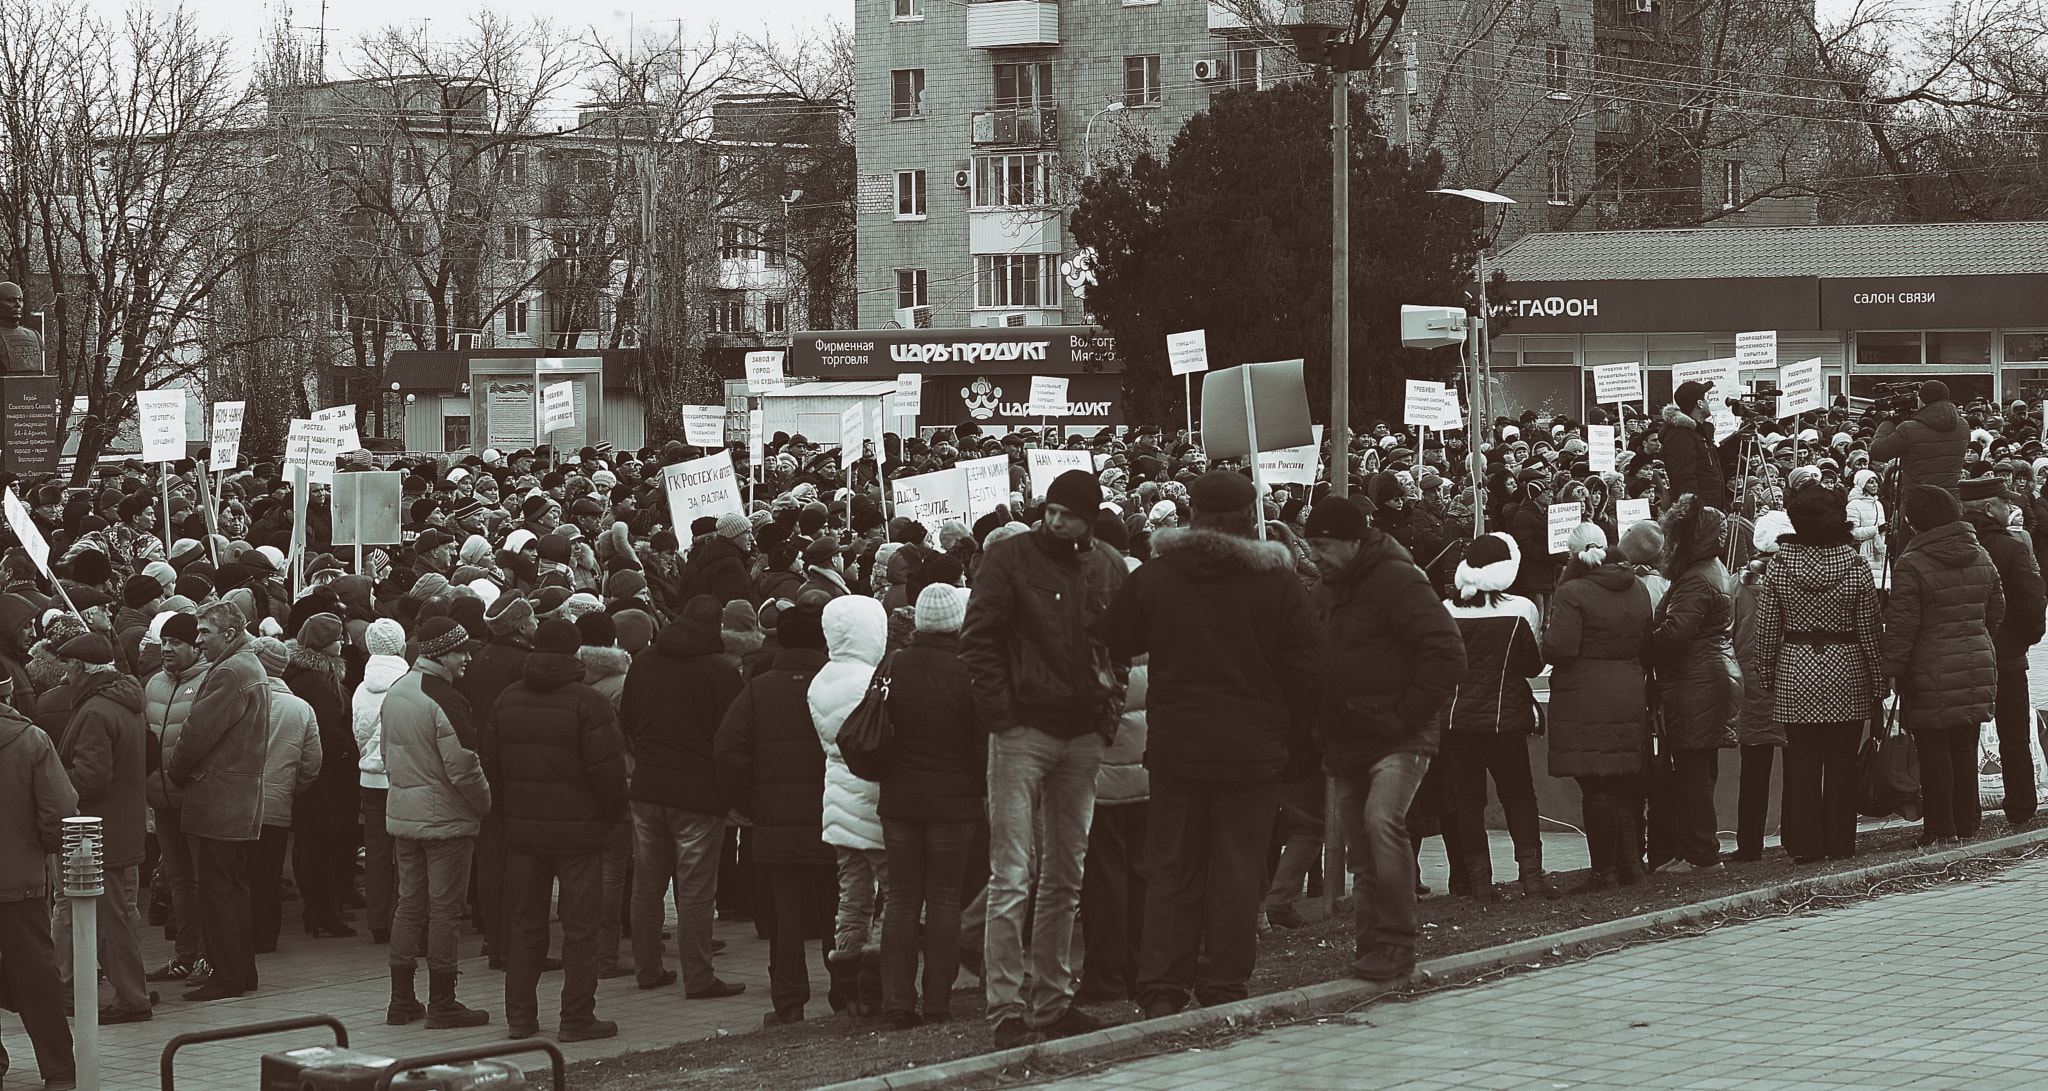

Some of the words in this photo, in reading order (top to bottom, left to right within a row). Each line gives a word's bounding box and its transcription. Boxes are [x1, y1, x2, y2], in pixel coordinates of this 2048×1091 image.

[1853, 293, 1895, 304] салон
[1898, 292, 1936, 303] связи
[1738, 334, 1774, 342] СОКРАЩЕНИЕ
[814, 339, 874, 352] Фирменная
[821, 355, 869, 368] торговля
[1738, 358, 1774, 366] ЛИКВИДАЦИЯ
[1700, 367, 1727, 375] ДОСТОЙНА
[1787, 366, 1813, 377] РАБОТНИКИ
[1413, 385, 1436, 393] ТРЕБУЕМ
[1789, 397, 1809, 407] СГОВОРА
[319, 413, 331, 422] МЫ
[337, 410, 347, 418] ЗА
[1035, 453, 1051, 466] НАМ
[1057, 454, 1081, 465] НУЖНА
[1277, 459, 1305, 470] России
[687, 497, 699, 510] ЗА
[700, 489, 729, 506] РАЗВАЛ
